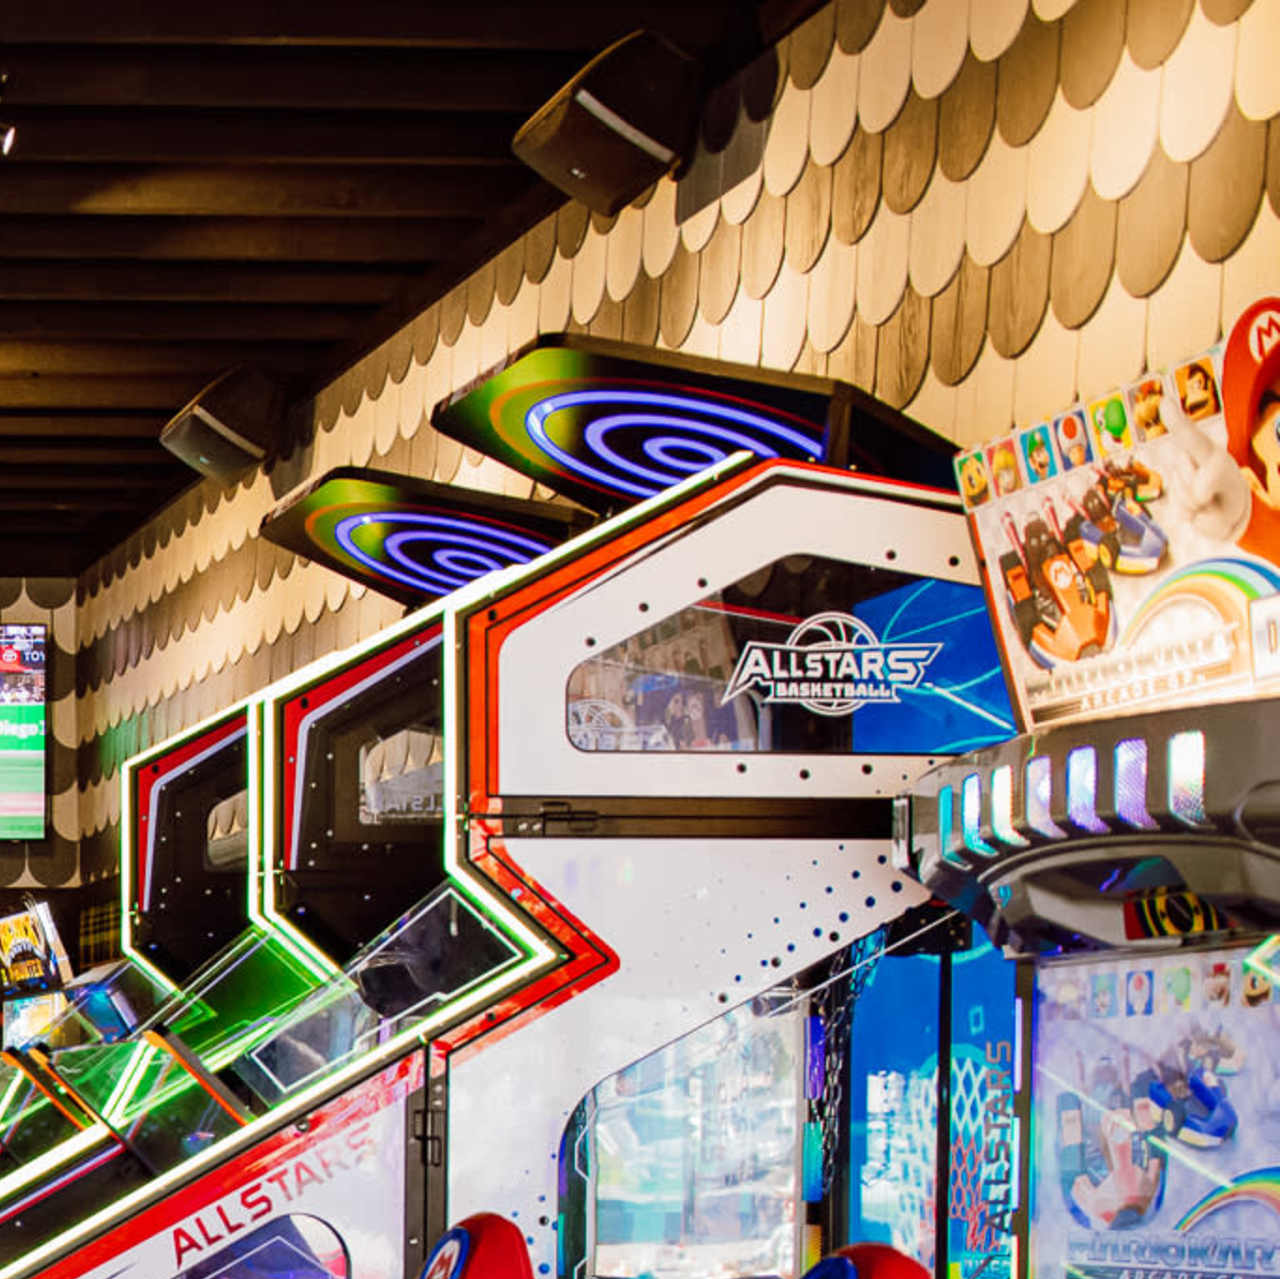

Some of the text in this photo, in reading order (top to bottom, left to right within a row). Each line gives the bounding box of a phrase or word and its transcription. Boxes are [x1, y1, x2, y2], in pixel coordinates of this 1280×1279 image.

[735, 648, 931, 686] ALLSTARS
[775, 682, 892, 697] BASKETBALL
[985, 1040, 1012, 1233] ALLSTARS
[172, 1122, 378, 1269] ALLSTARS
